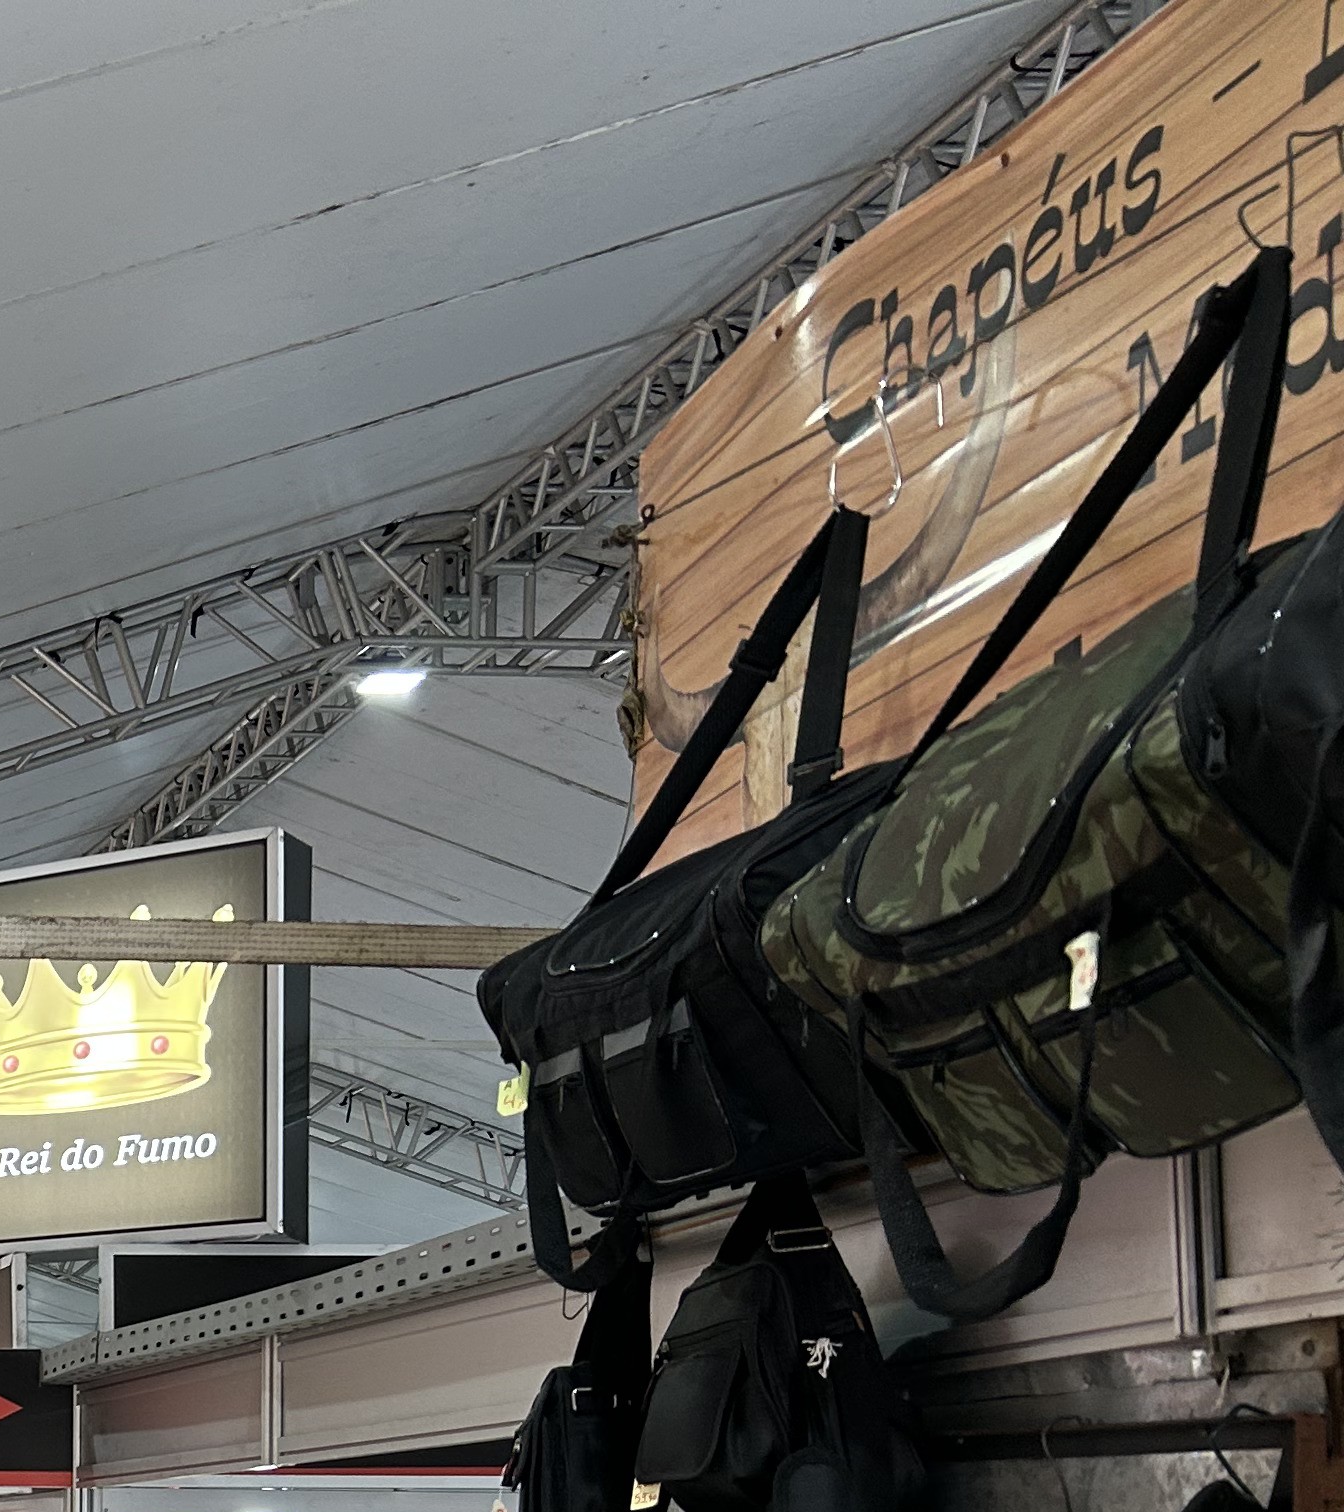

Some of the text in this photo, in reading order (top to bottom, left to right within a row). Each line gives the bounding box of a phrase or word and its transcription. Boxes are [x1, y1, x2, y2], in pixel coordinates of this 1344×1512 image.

[822, 124, 1164, 445] Chapéus
[60, 1138, 104, 1172] do
[112, 1133, 217, 1166] Fumo
